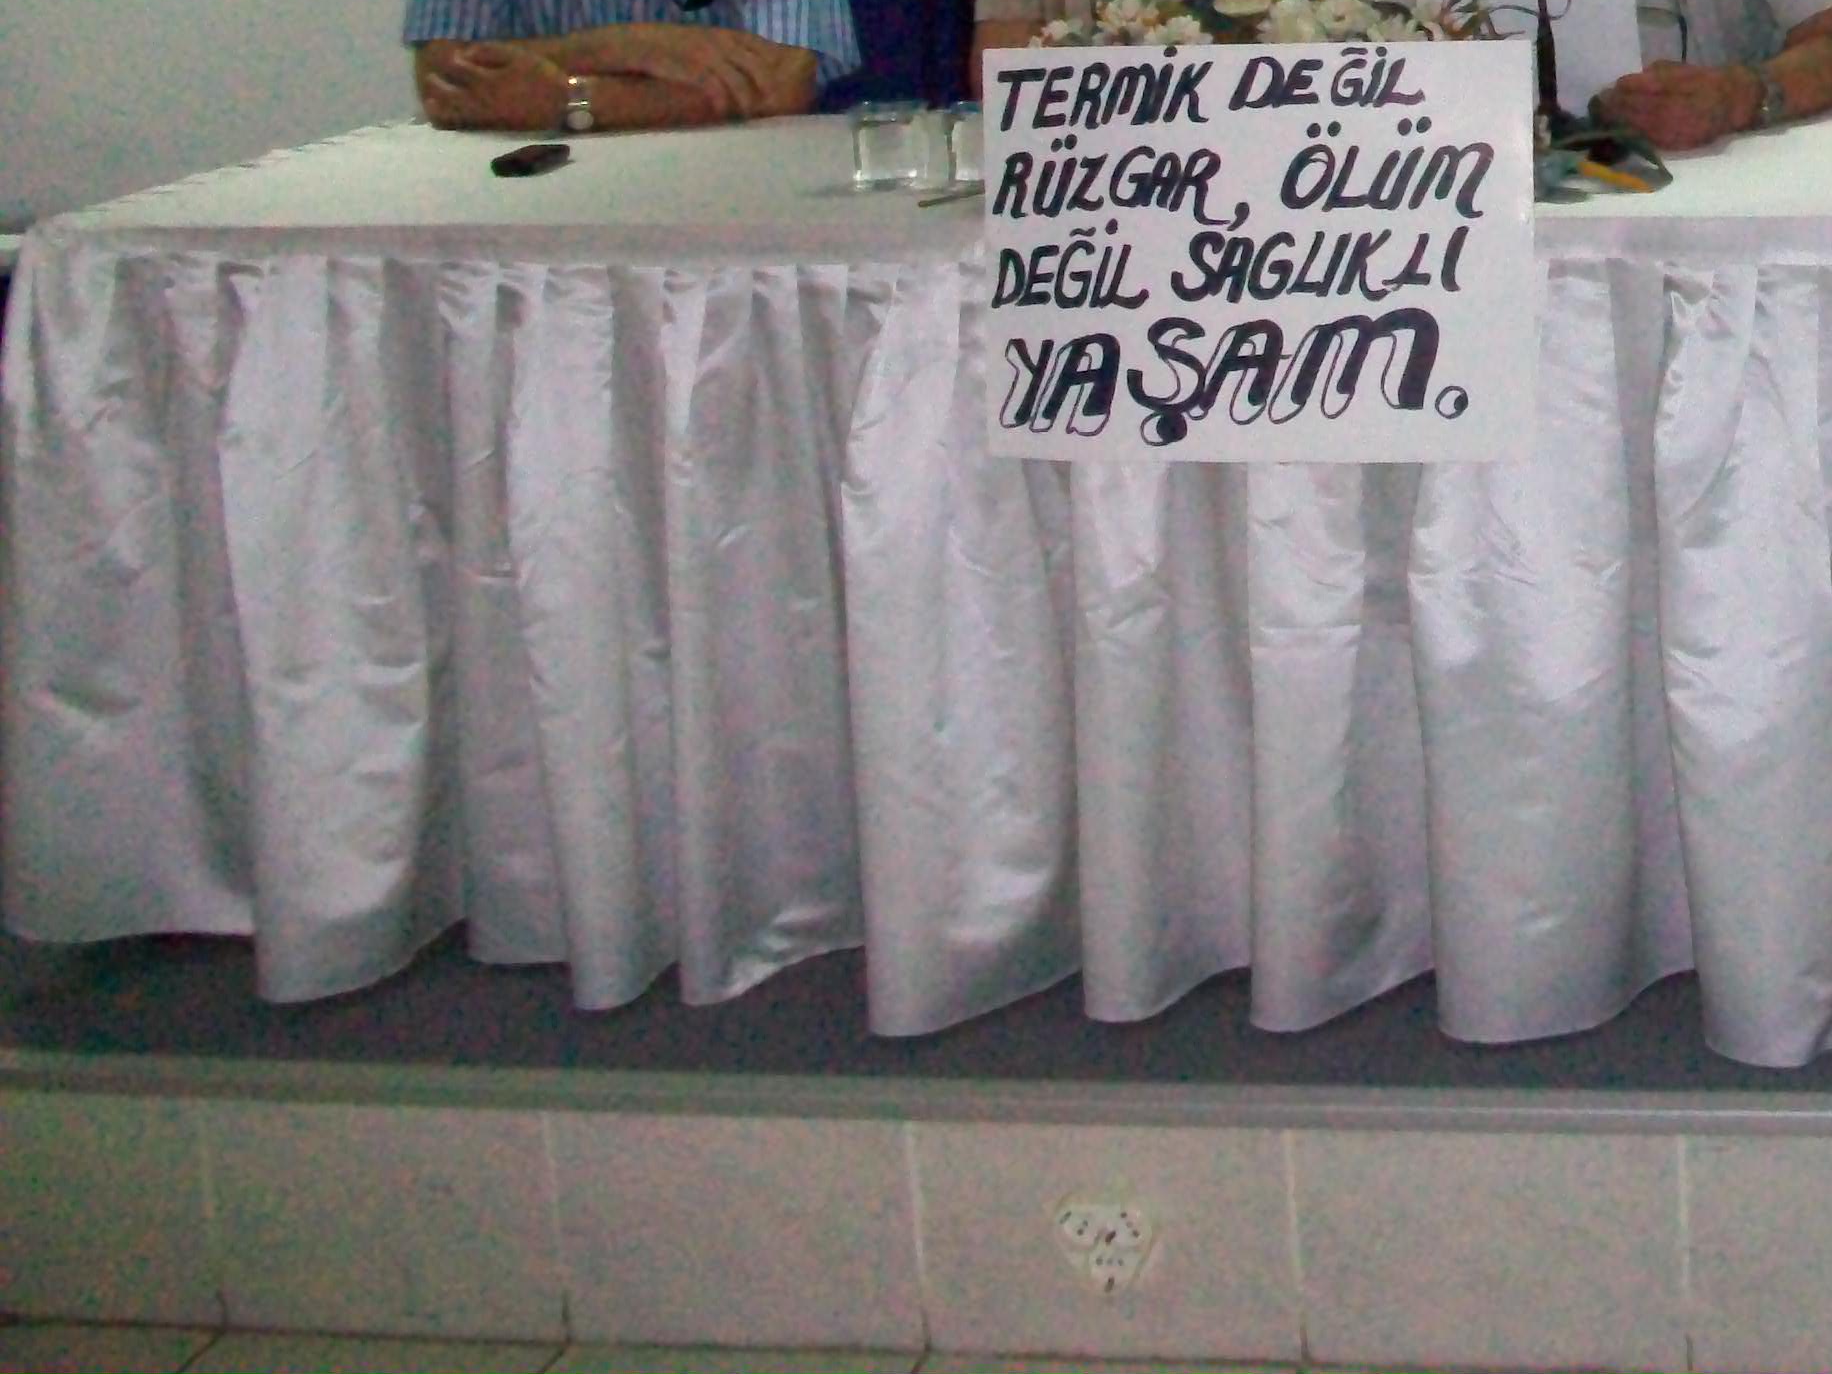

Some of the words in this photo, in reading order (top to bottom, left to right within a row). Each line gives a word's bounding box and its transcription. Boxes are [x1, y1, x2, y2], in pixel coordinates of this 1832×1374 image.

[997, 46, 1214, 131] TERMİK
[1229, 46, 1425, 111] DEĞİL
[992, 135, 1250, 231] RÜZGAR,
[1280, 117, 1495, 219] ÖLÜM
[991, 219, 1149, 309] DEĞİL
[1000, 308, 1469, 446] YAŞAM.
